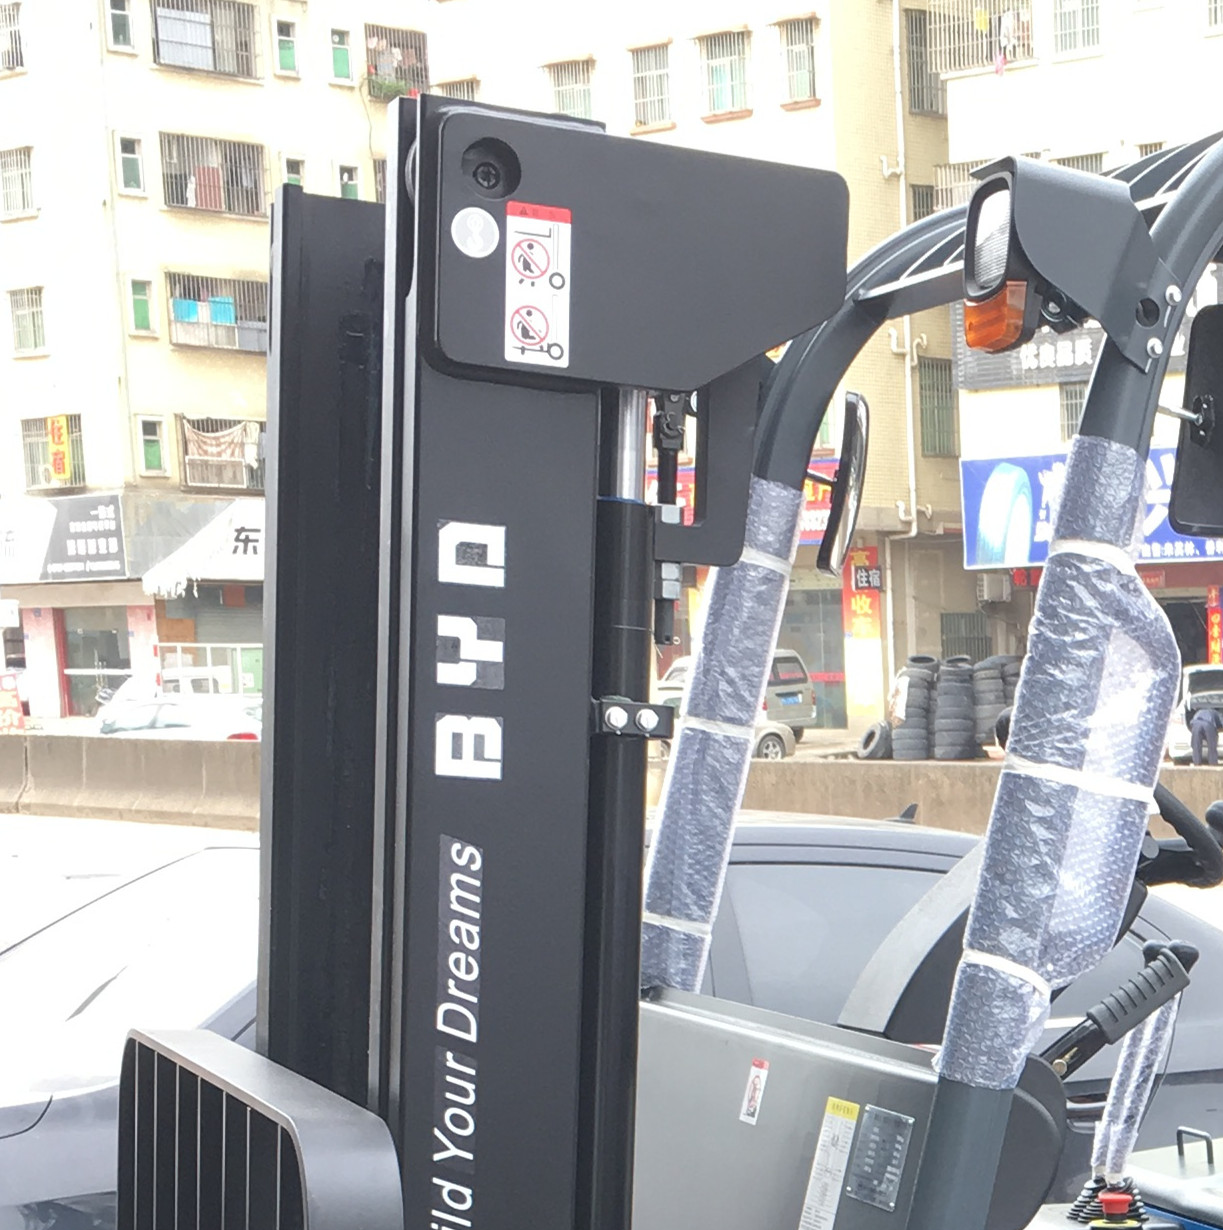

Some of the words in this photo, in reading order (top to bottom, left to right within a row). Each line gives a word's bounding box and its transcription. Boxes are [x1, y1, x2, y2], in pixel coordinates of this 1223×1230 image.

[232, 526, 261, 555] 东
[857, 569, 880, 588] 住宿
[435, 521, 506, 779] BYD
[437, 841, 481, 1043] Dreams
[433, 1050, 475, 1162] Your
